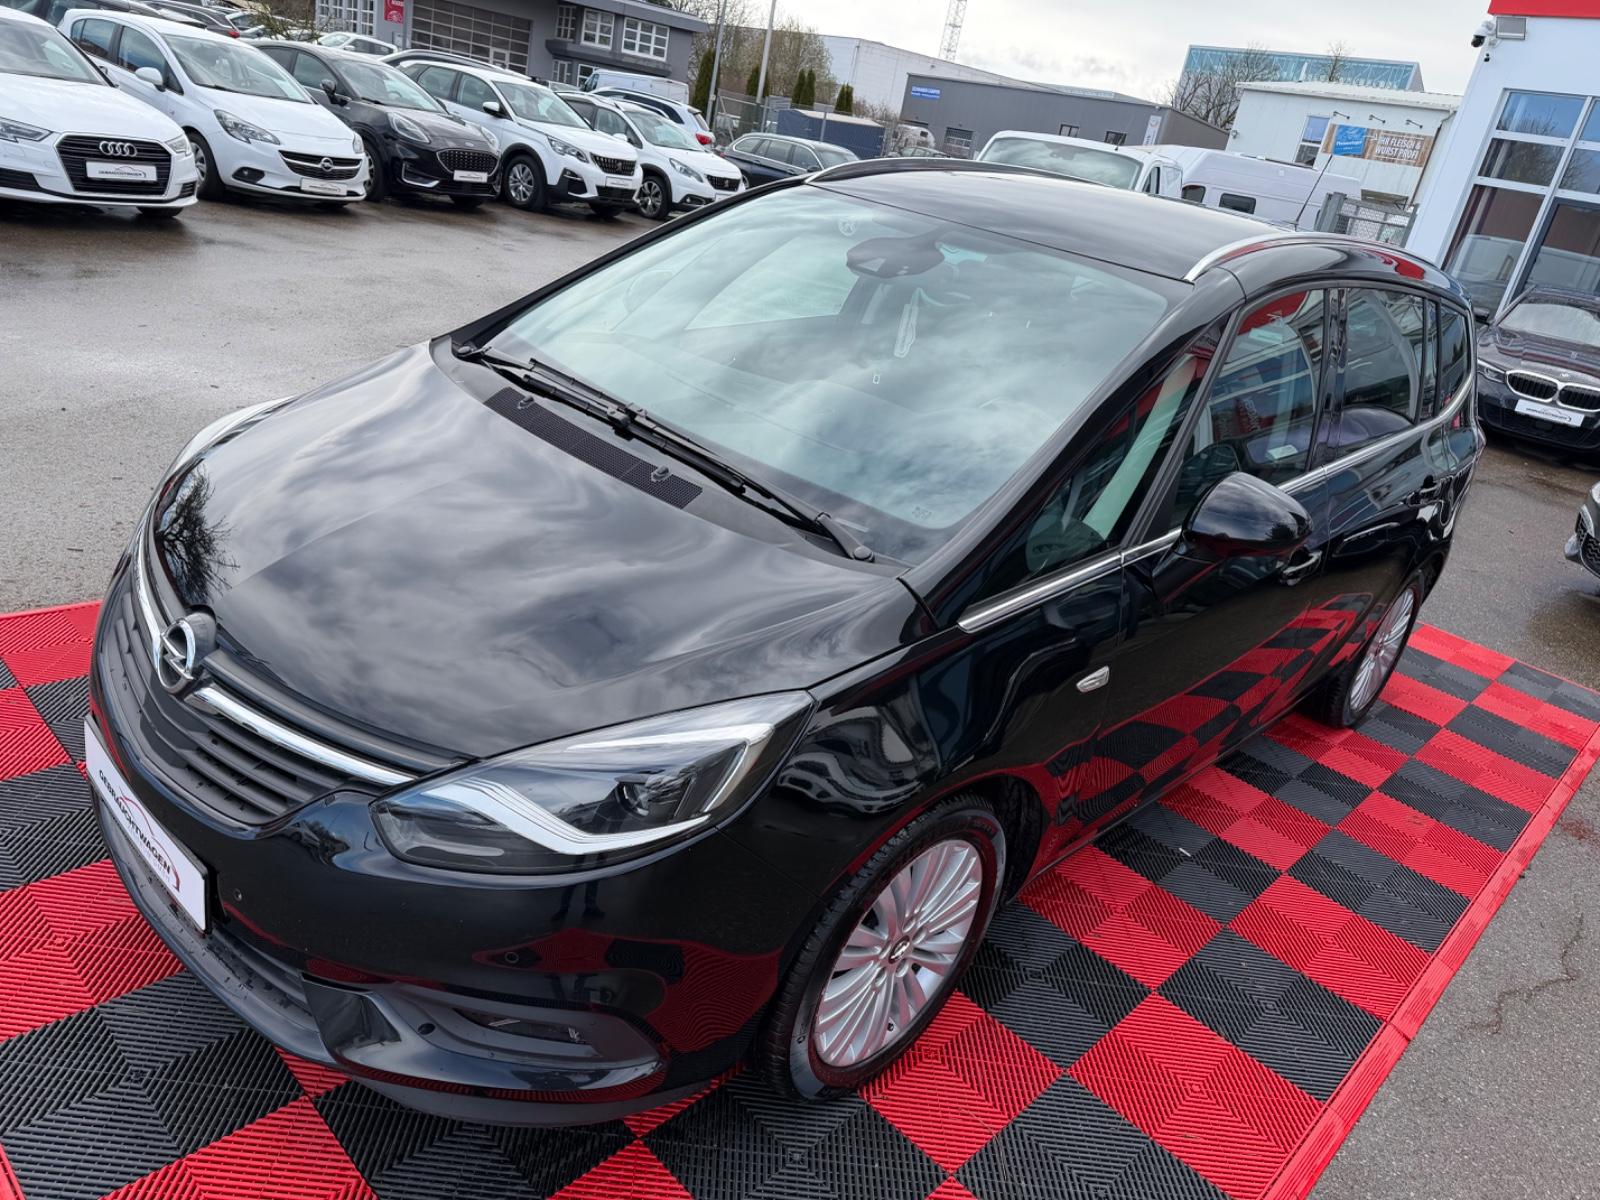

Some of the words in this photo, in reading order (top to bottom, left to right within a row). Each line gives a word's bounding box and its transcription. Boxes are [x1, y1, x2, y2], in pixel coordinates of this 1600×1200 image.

[1390, 136, 1415, 149] FLEISCH
[1375, 146, 1398, 157] WURST
[1397, 148, 1419, 160] PROFI
[99, 769, 171, 874] GEBRAUCHTWAGEN
